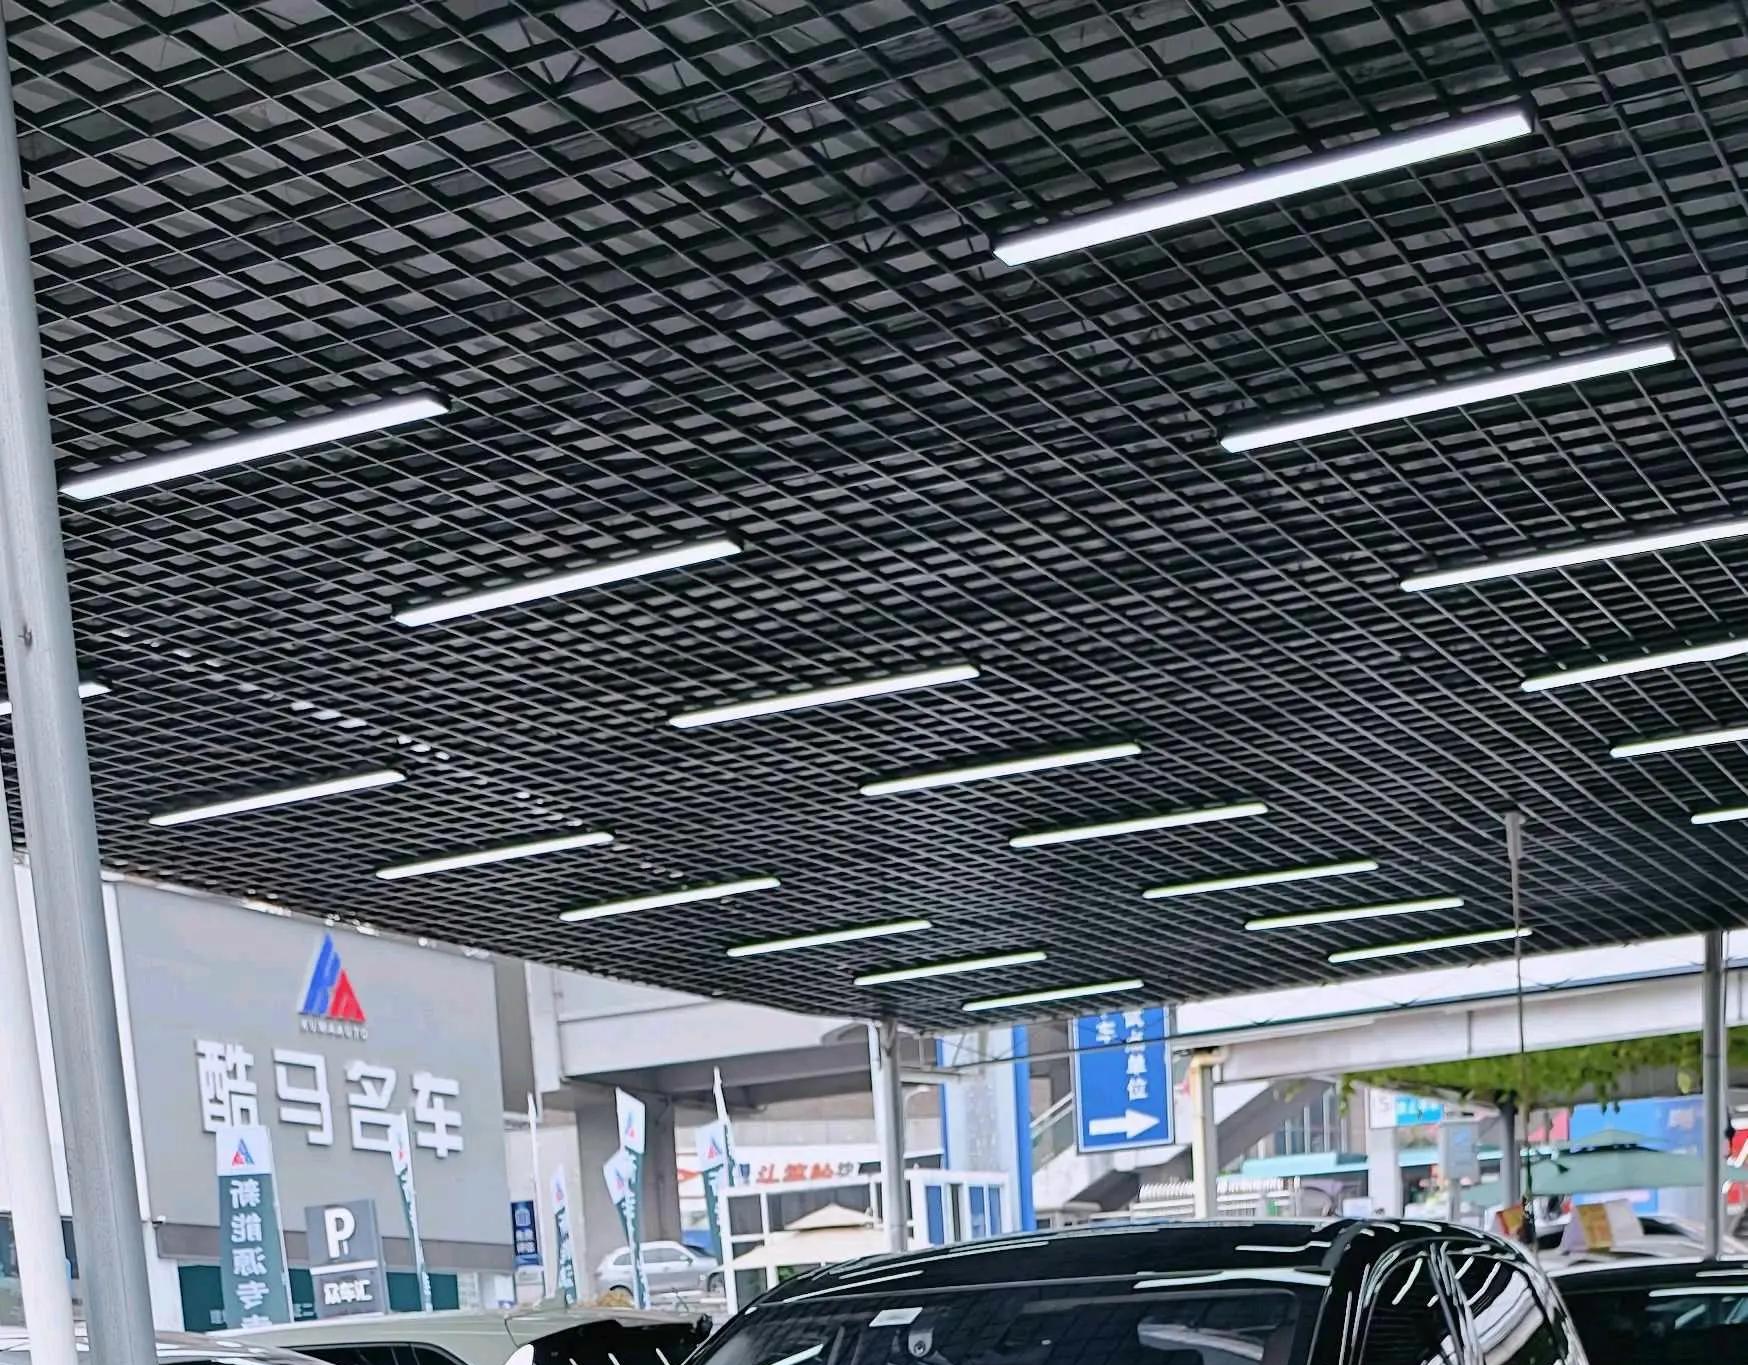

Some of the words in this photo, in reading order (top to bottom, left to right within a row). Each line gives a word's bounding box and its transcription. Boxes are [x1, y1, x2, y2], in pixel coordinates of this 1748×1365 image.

[195, 1039, 464, 1159] 酷马名车
[324, 1207, 357, 1259] P
